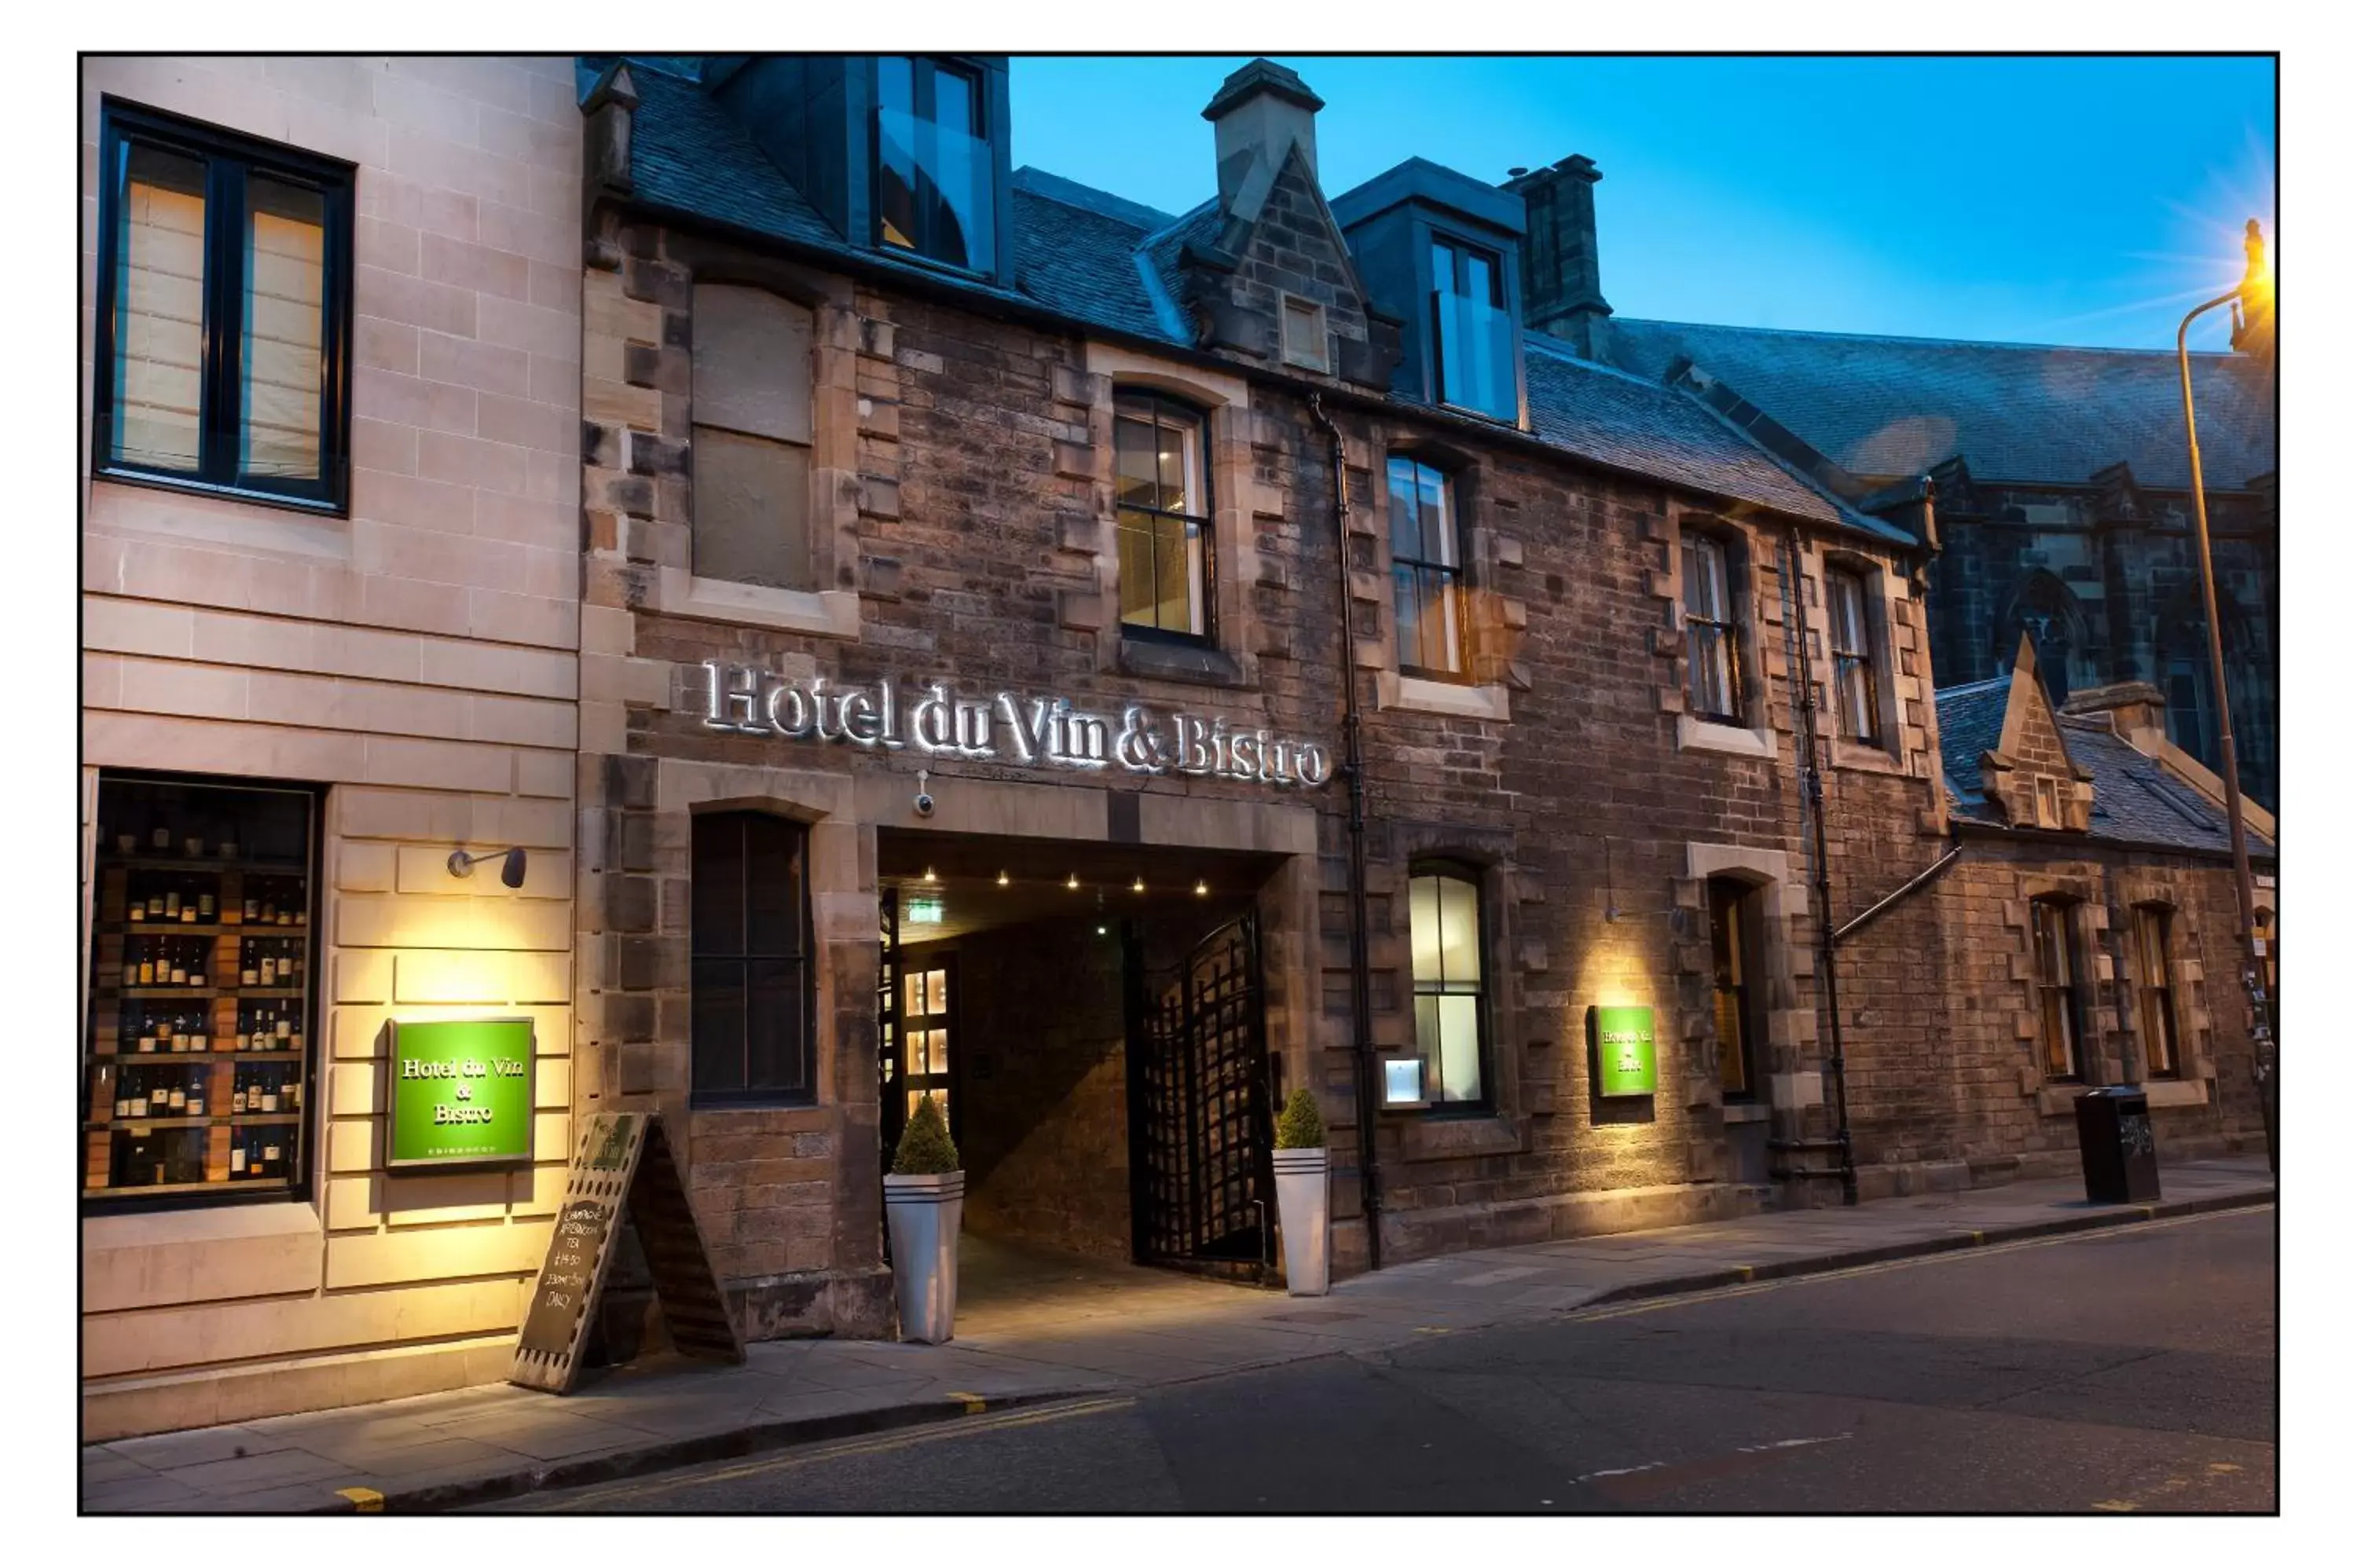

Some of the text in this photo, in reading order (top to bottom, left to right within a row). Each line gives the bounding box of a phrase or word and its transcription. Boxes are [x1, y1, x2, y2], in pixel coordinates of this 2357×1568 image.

[702, 658, 1333, 786] Hotel du Vin & Bistro
[401, 1057, 524, 1079] Hotel du Vin
[456, 1084, 471, 1101] &
[434, 1104, 493, 1125] Bistro
